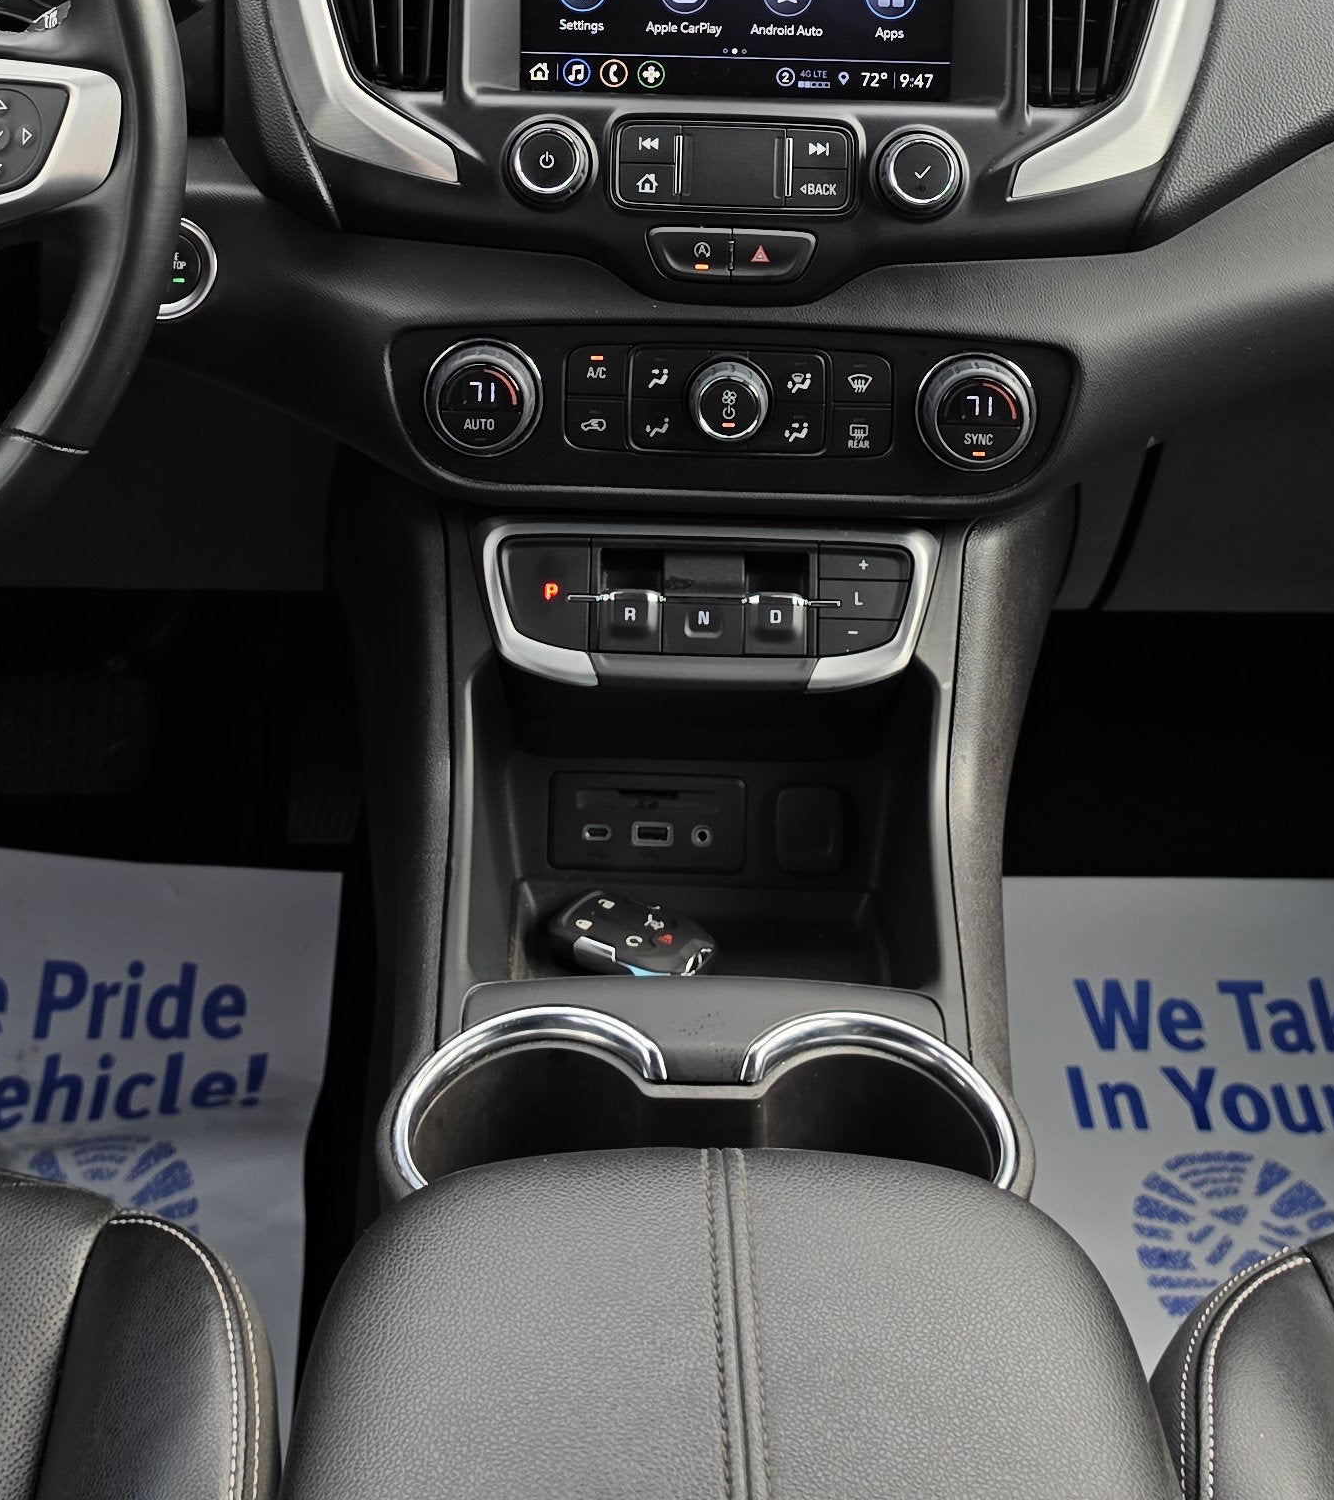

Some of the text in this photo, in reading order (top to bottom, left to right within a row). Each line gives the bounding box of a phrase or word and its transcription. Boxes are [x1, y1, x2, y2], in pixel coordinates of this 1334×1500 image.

[559, 18, 605, 34] Settings
[645, 22, 723, 38] Apple CarPlay
[750, 23, 824, 38] Android Auto
[875, 27, 905, 41] Apps
[899, 73, 934, 90] 9:47
[806, 181, 837, 198] BACK
[586, 365, 607, 380] A/C
[463, 417, 495, 432] AUTO
[848, 439, 870, 450] REAR
[963, 433, 994, 447] SYNC
[544, 583, 559, 600] P
[854, 592, 863, 606] L
[624, 607, 637, 622] R
[698, 611, 710, 625] N
[770, 609, 782, 624] D
[32, 959, 248, 1041] Pride
[1073, 978, 1205, 1053] We
[1066, 1064, 1149, 1130] In
